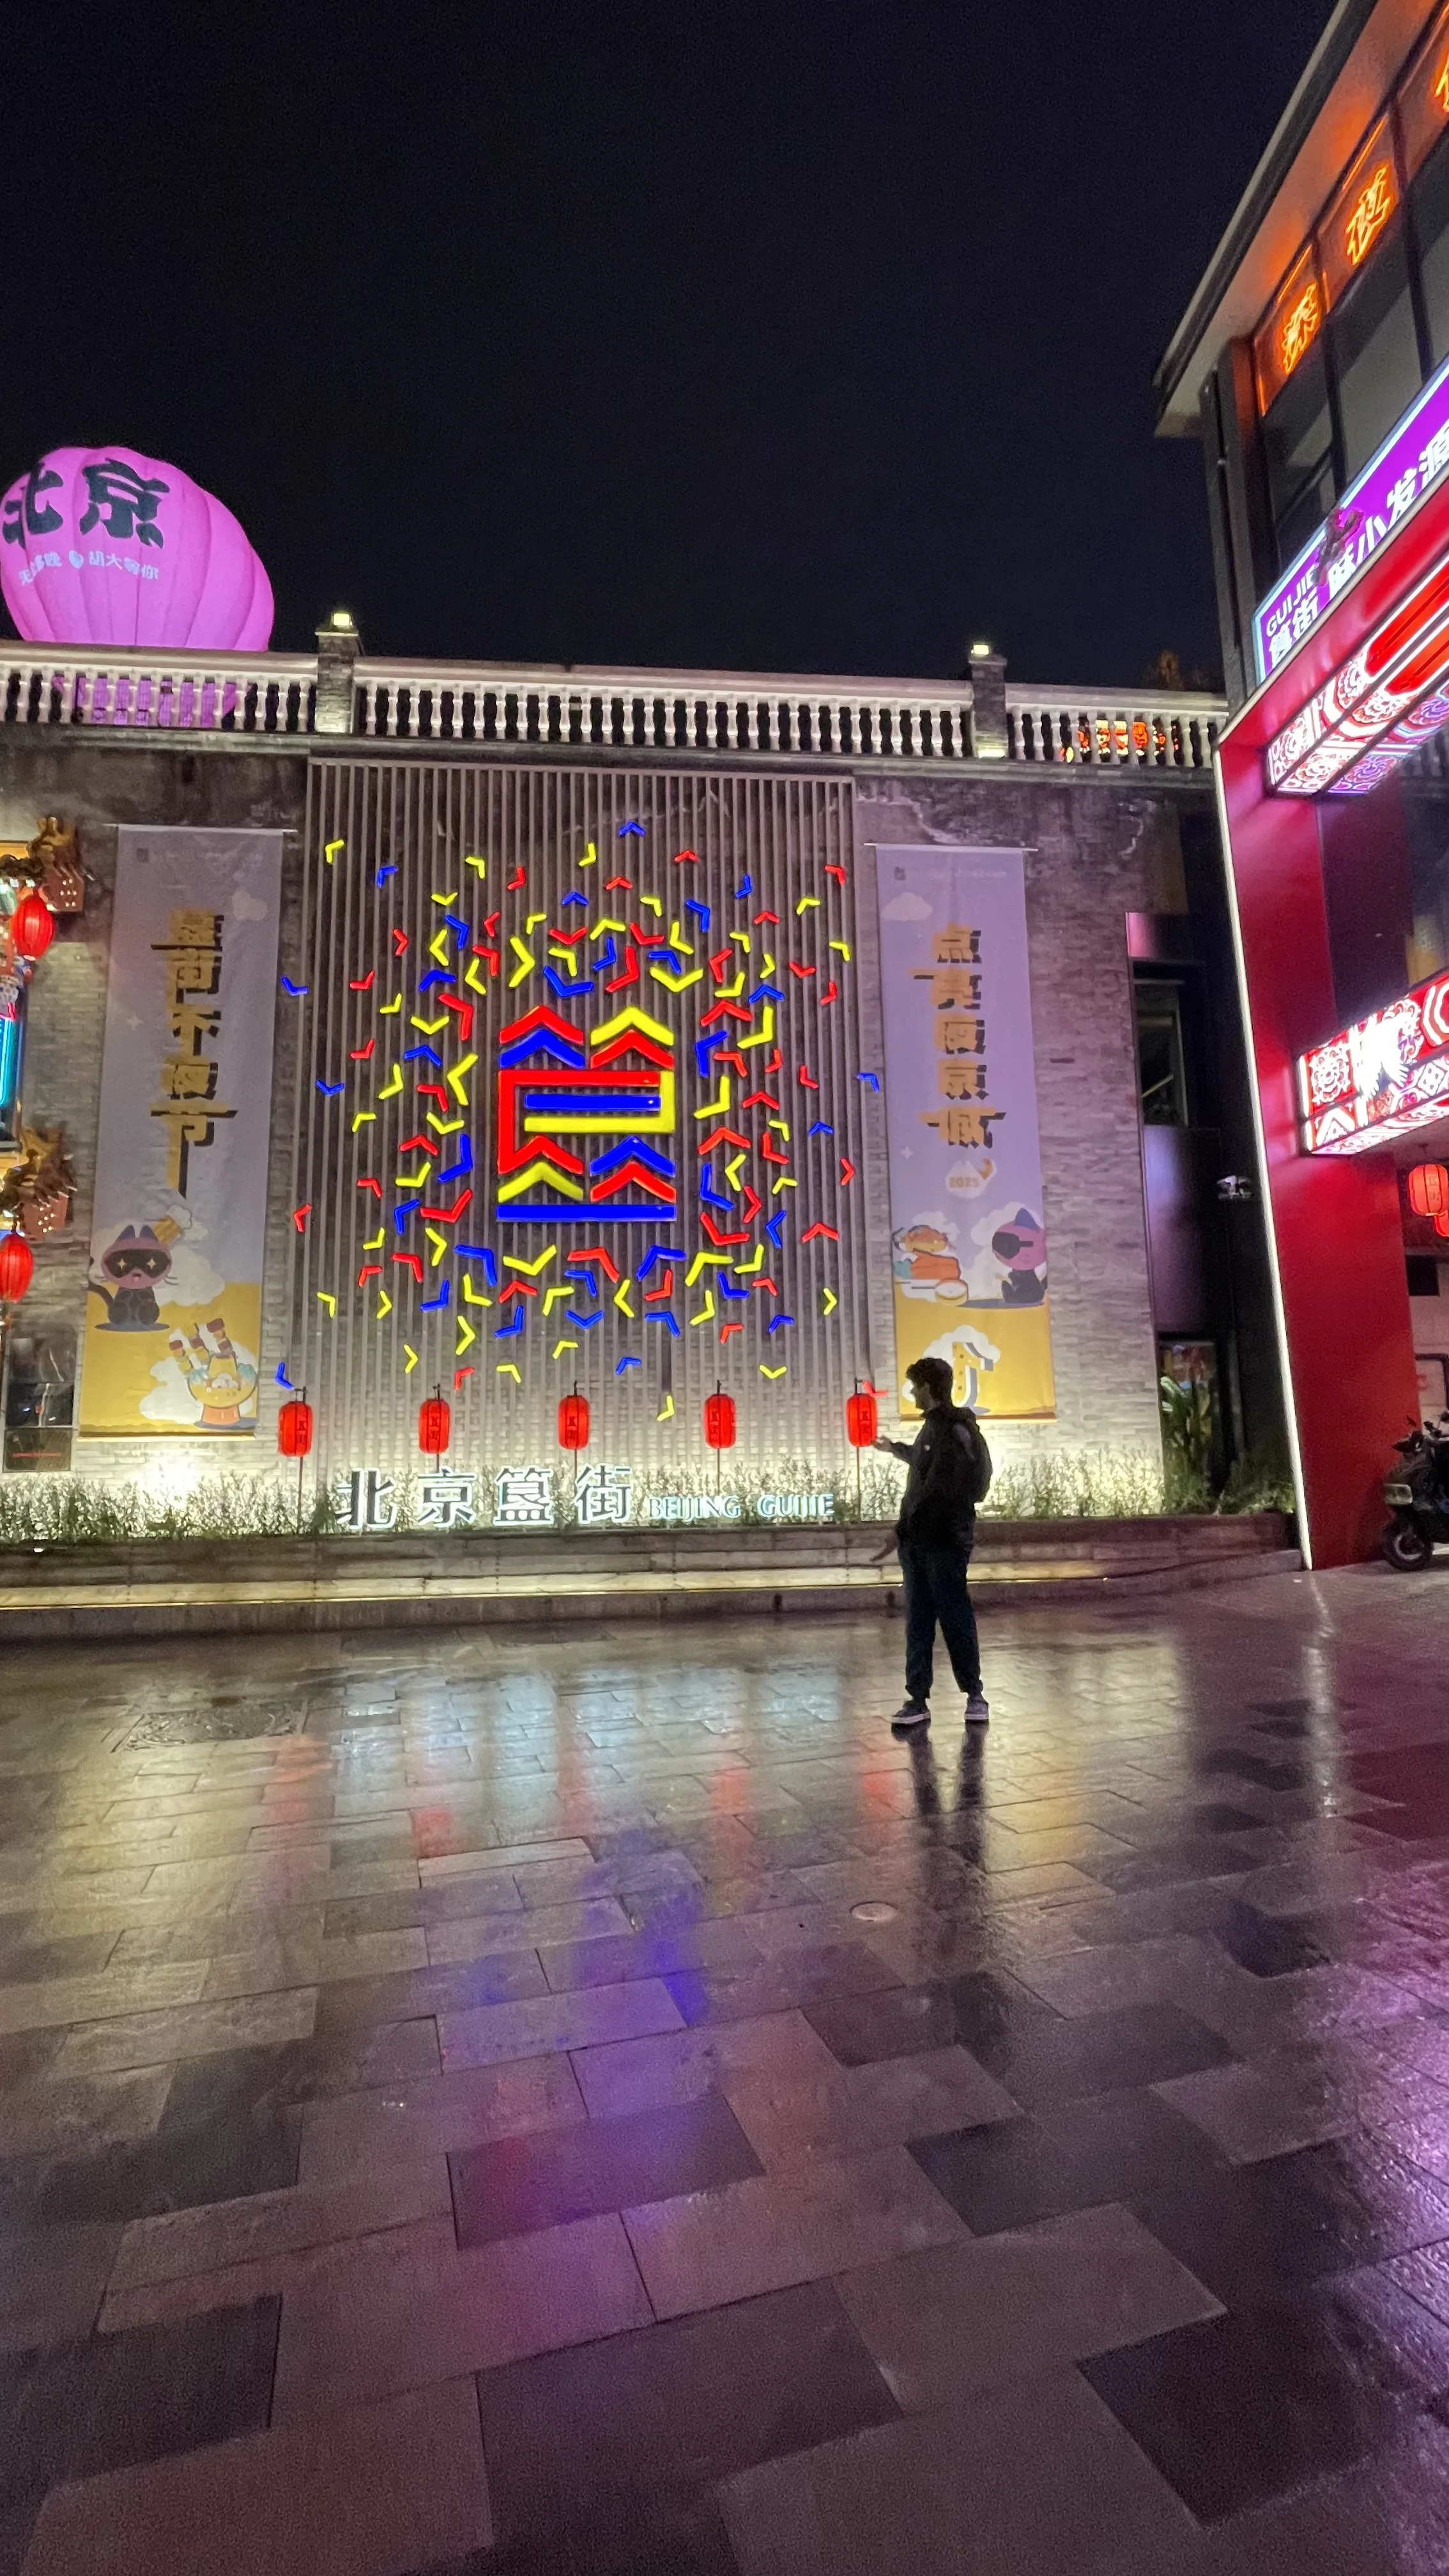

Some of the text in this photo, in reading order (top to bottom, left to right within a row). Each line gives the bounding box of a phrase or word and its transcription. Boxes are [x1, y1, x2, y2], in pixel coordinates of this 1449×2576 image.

[3, 457, 170, 549] 北京
[335, 1462, 632, 1529] 北京簋街
[648, 1493, 835, 1524] BEIJING GUIJIE
